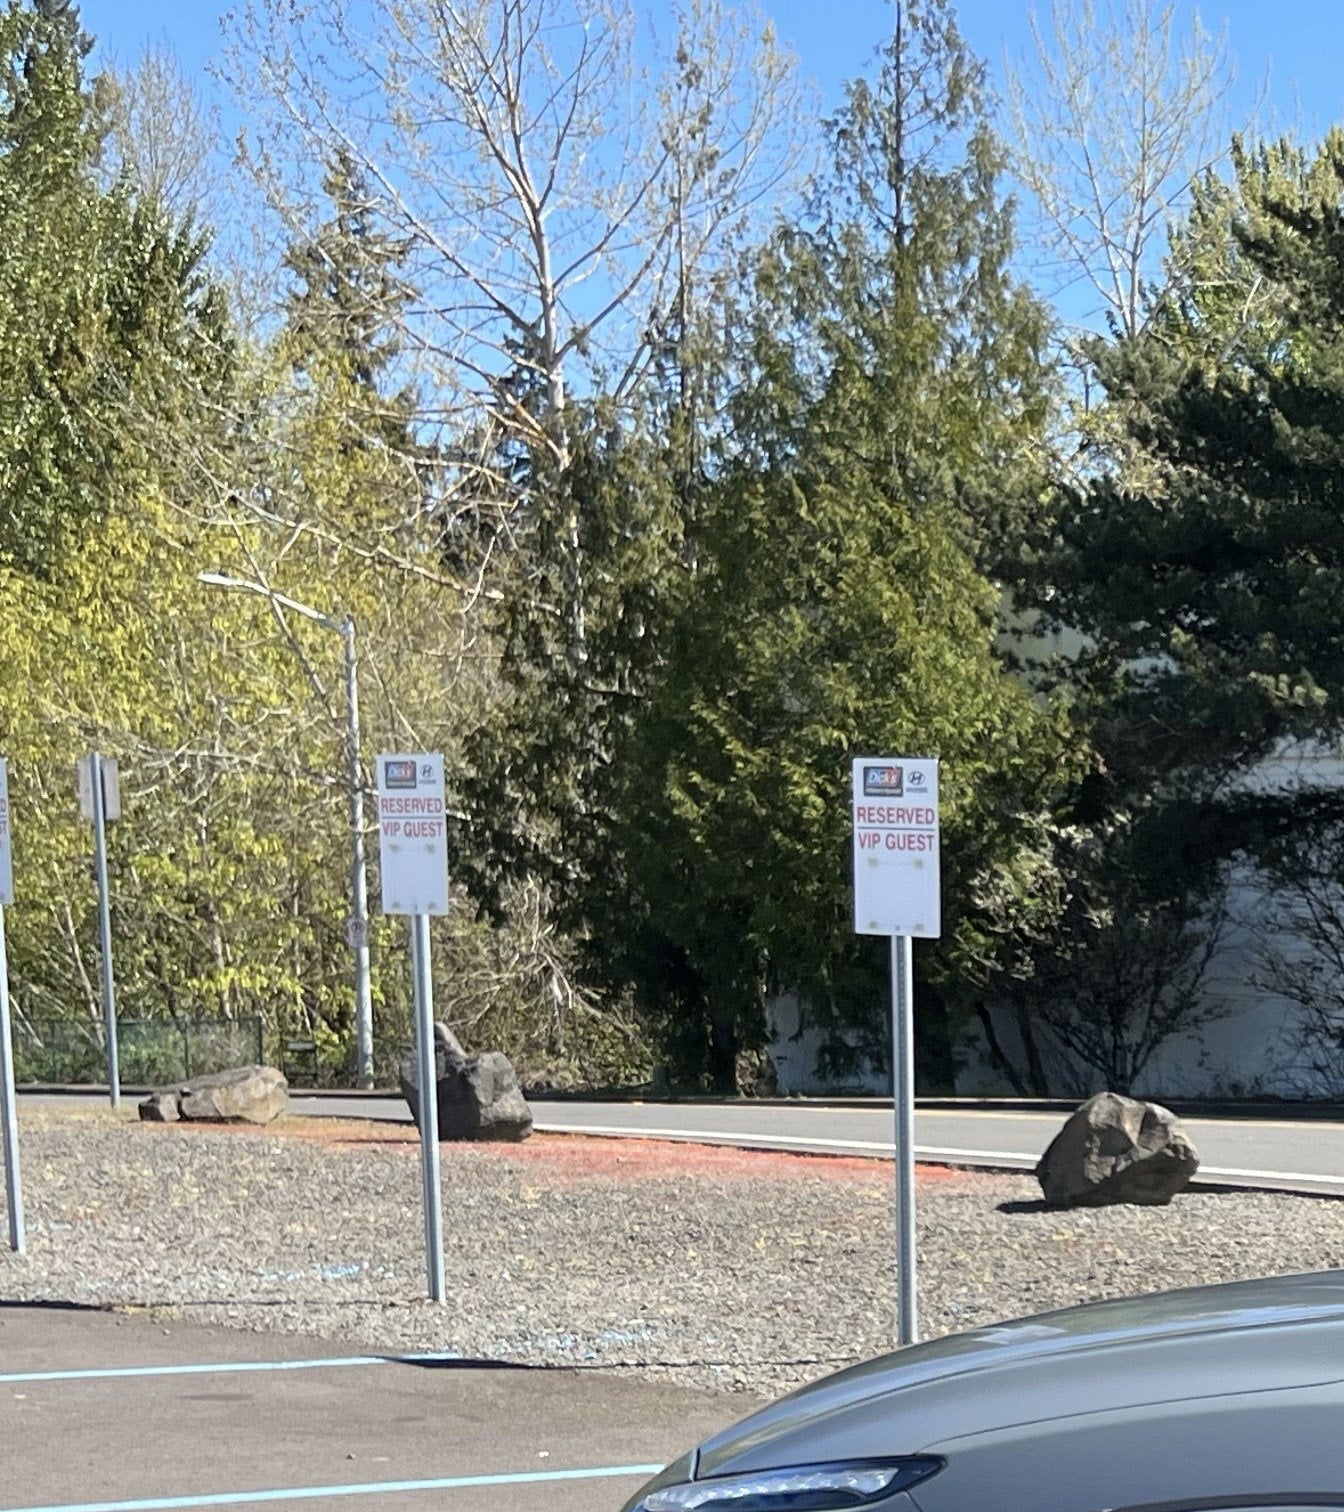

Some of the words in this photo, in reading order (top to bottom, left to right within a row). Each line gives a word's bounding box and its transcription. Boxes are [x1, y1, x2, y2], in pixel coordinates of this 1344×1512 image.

[381, 798, 442, 813] RESERVED
[857, 806, 935, 825] RESERVED
[382, 821, 400, 837] VIP
[403, 821, 442, 837] GUEST
[858, 832, 881, 849] VIP
[885, 833, 935, 851] GUEST
